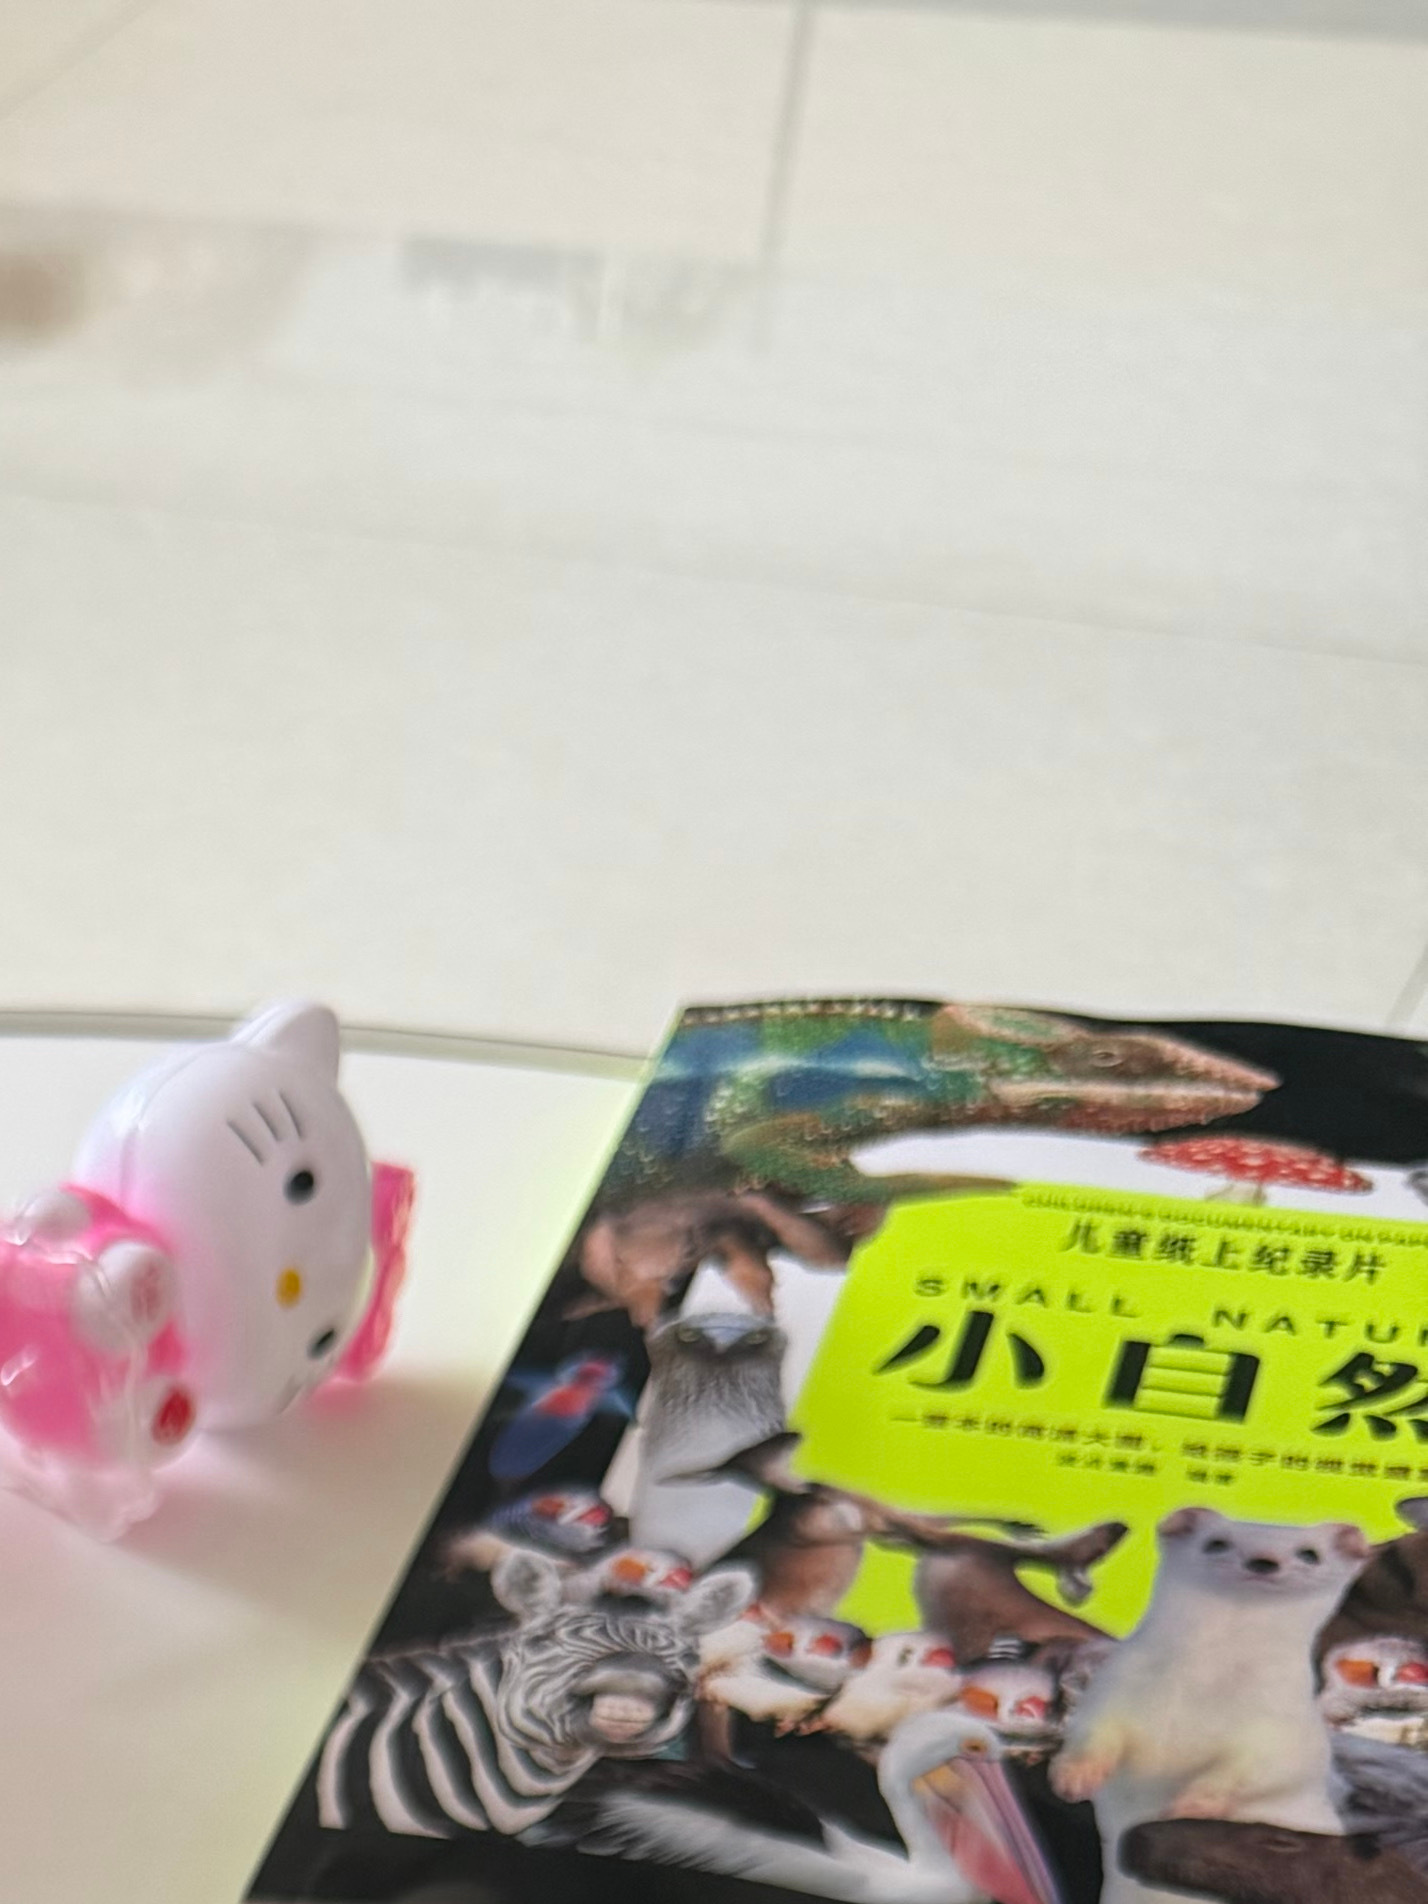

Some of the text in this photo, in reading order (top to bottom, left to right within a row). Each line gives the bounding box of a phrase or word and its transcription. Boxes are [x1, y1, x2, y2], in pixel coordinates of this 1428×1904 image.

[1059, 1216, 1387, 1284] 儿童纸上纪录片
[914, 1274, 1141, 1319] SMALL
[872, 1310, 1428, 1444] 小自然
